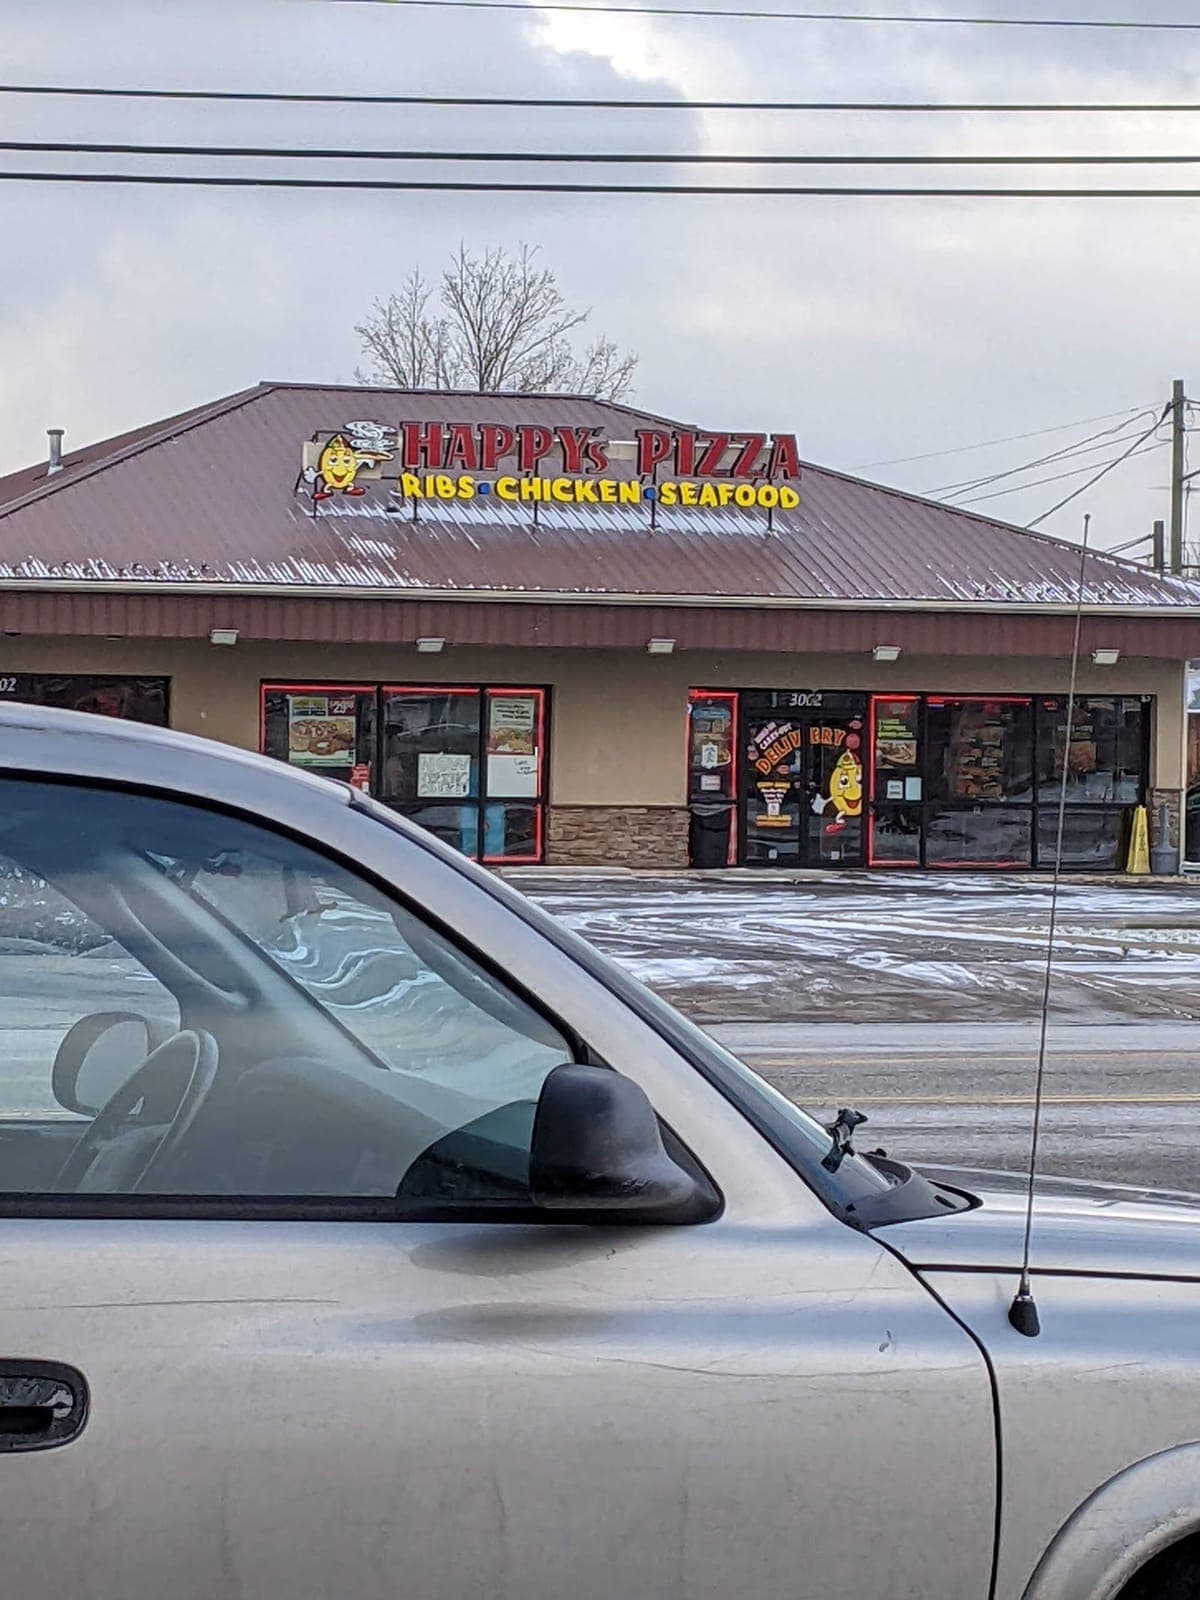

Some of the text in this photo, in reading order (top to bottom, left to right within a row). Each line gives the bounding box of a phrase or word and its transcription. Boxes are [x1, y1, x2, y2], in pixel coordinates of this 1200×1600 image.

[635, 429, 798, 480] PIZZA
[401, 473, 799, 509] RIBS CHICKEN SEAFOOD
